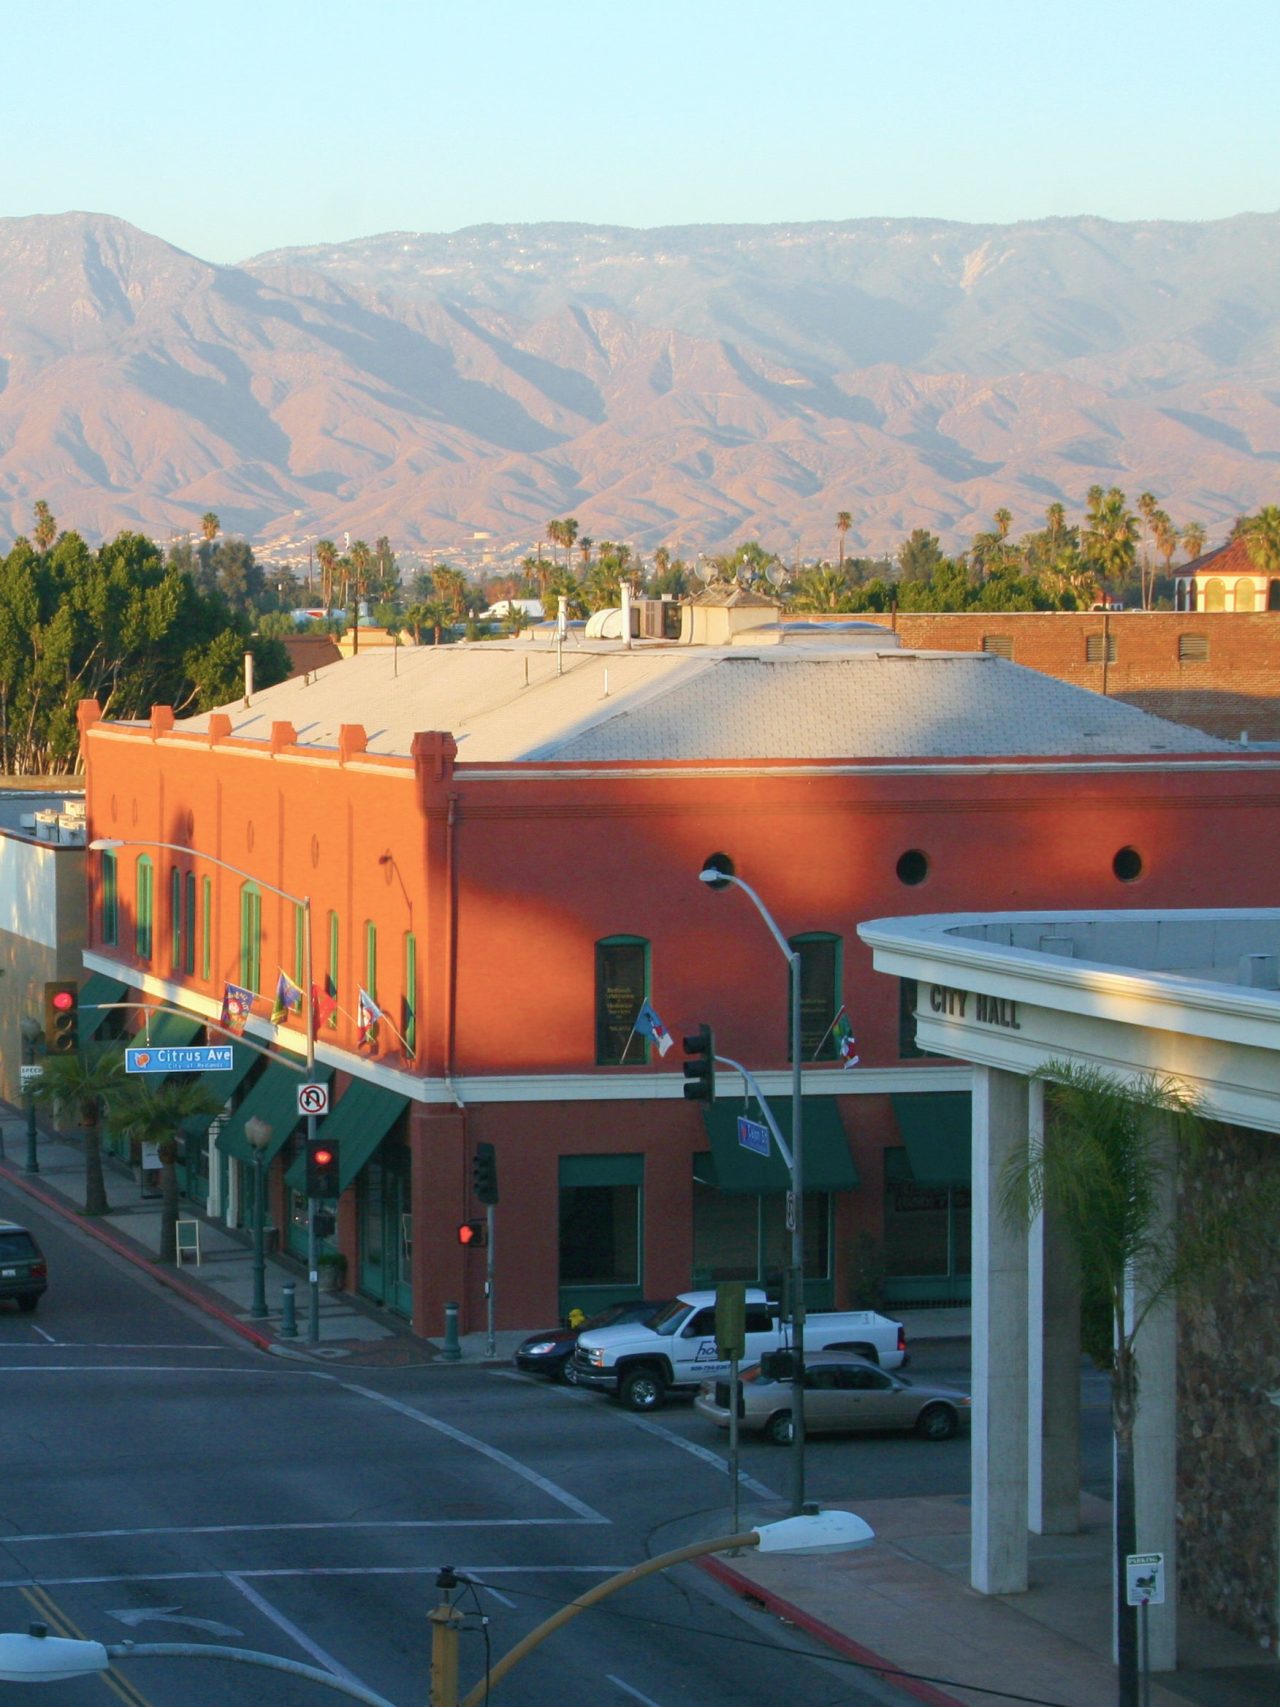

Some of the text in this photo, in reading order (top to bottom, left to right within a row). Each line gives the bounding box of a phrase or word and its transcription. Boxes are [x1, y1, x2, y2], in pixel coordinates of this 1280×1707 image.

[930, 984, 1020, 1030] CITY HALL
[157, 1049, 230, 1062] Citrus Ave
[1128, 1556, 1158, 1565] PARKING
